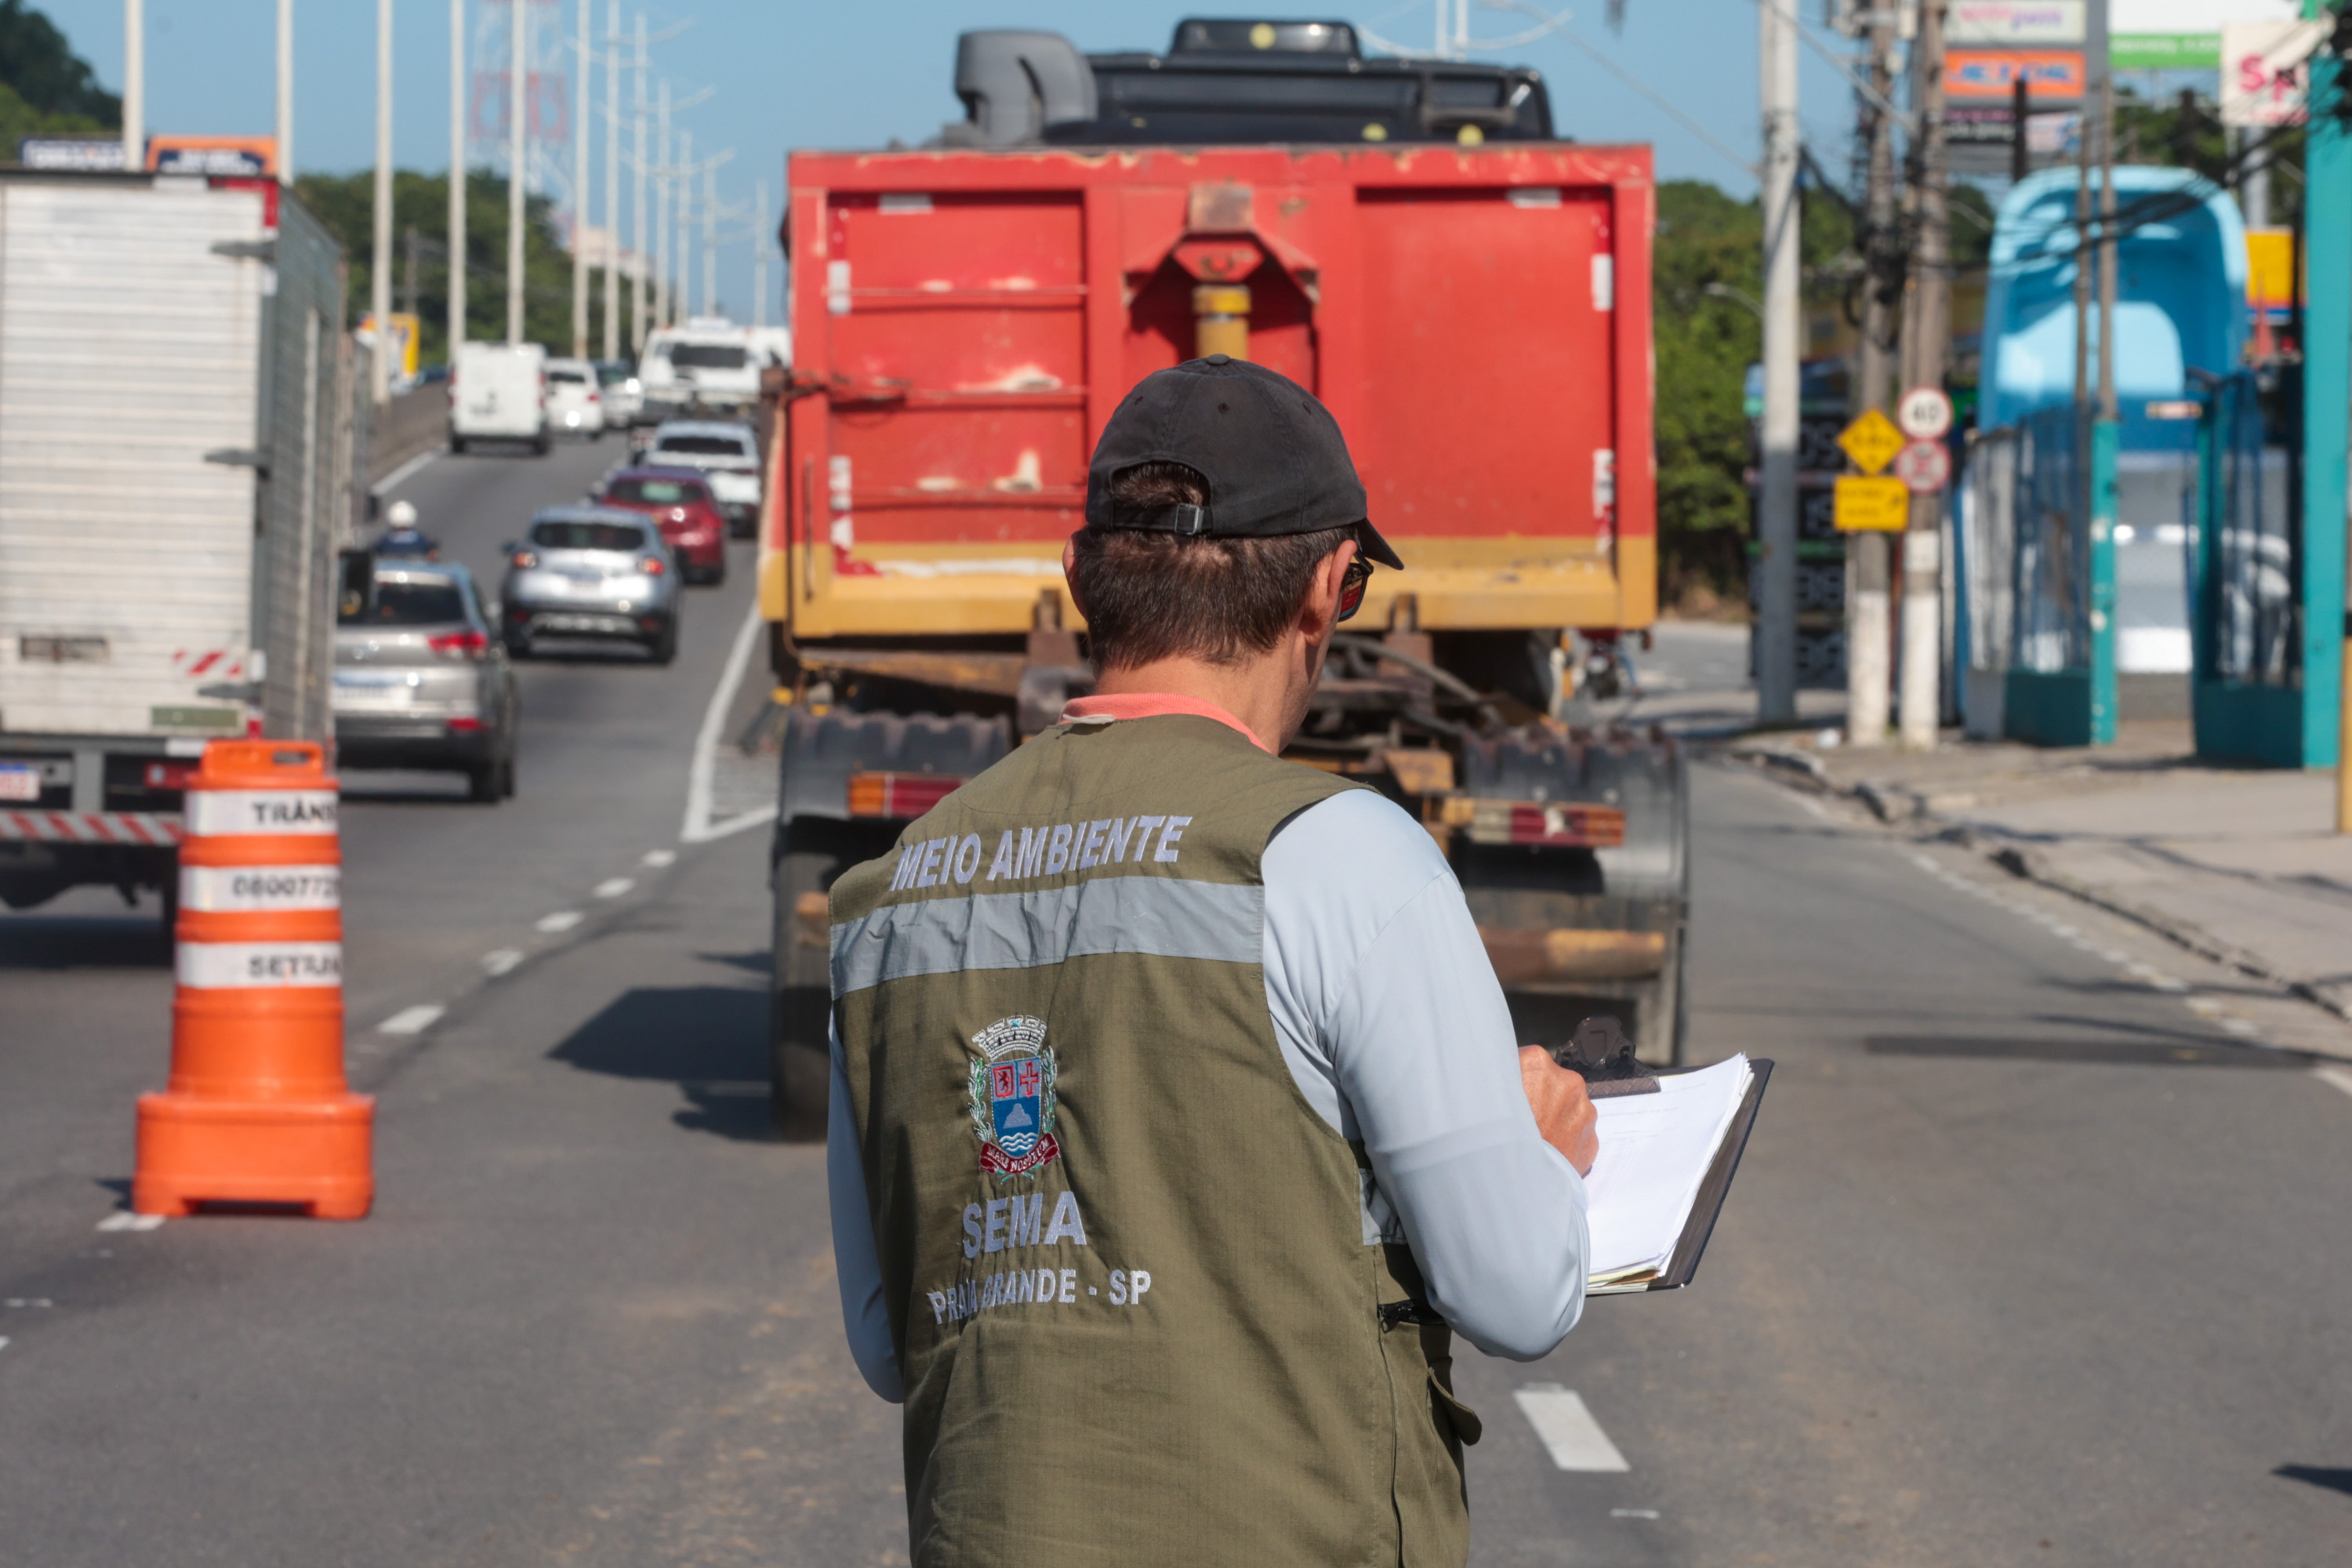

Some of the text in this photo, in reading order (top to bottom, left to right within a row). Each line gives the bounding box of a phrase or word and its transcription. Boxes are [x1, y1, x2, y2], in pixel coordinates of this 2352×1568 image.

[889, 815, 1193, 891] MEIO AMBIENTE
[985, 1143, 1011, 1170] MARE
[962, 1190, 1087, 1259] SEMA
[926, 1279, 978, 1325] PRAIA
[981, 1268, 1076, 1309] GRANDE
[1109, 1269, 1152, 1305] SP
